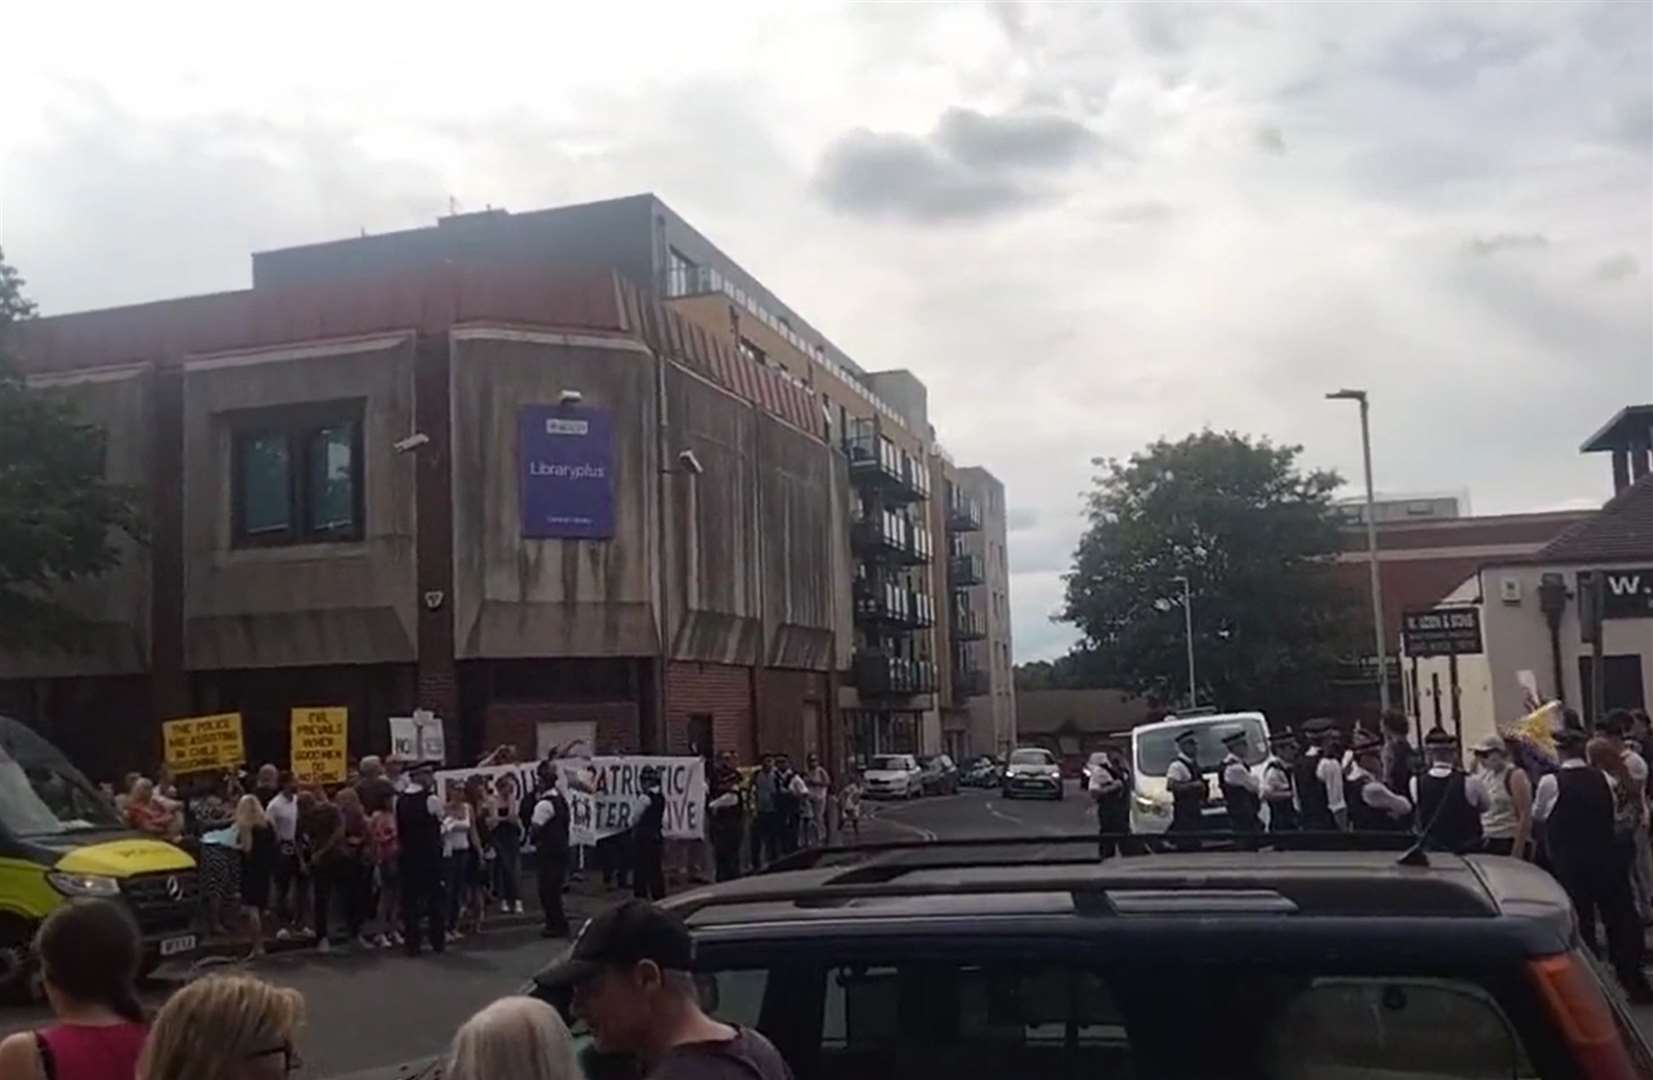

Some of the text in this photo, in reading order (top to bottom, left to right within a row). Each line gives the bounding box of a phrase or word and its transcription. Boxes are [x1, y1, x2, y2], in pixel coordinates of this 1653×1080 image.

[529, 461, 605, 480] Libraryplus
[172, 720, 230, 734] THE POLICE
[586, 765, 685, 797] PATRITIC
